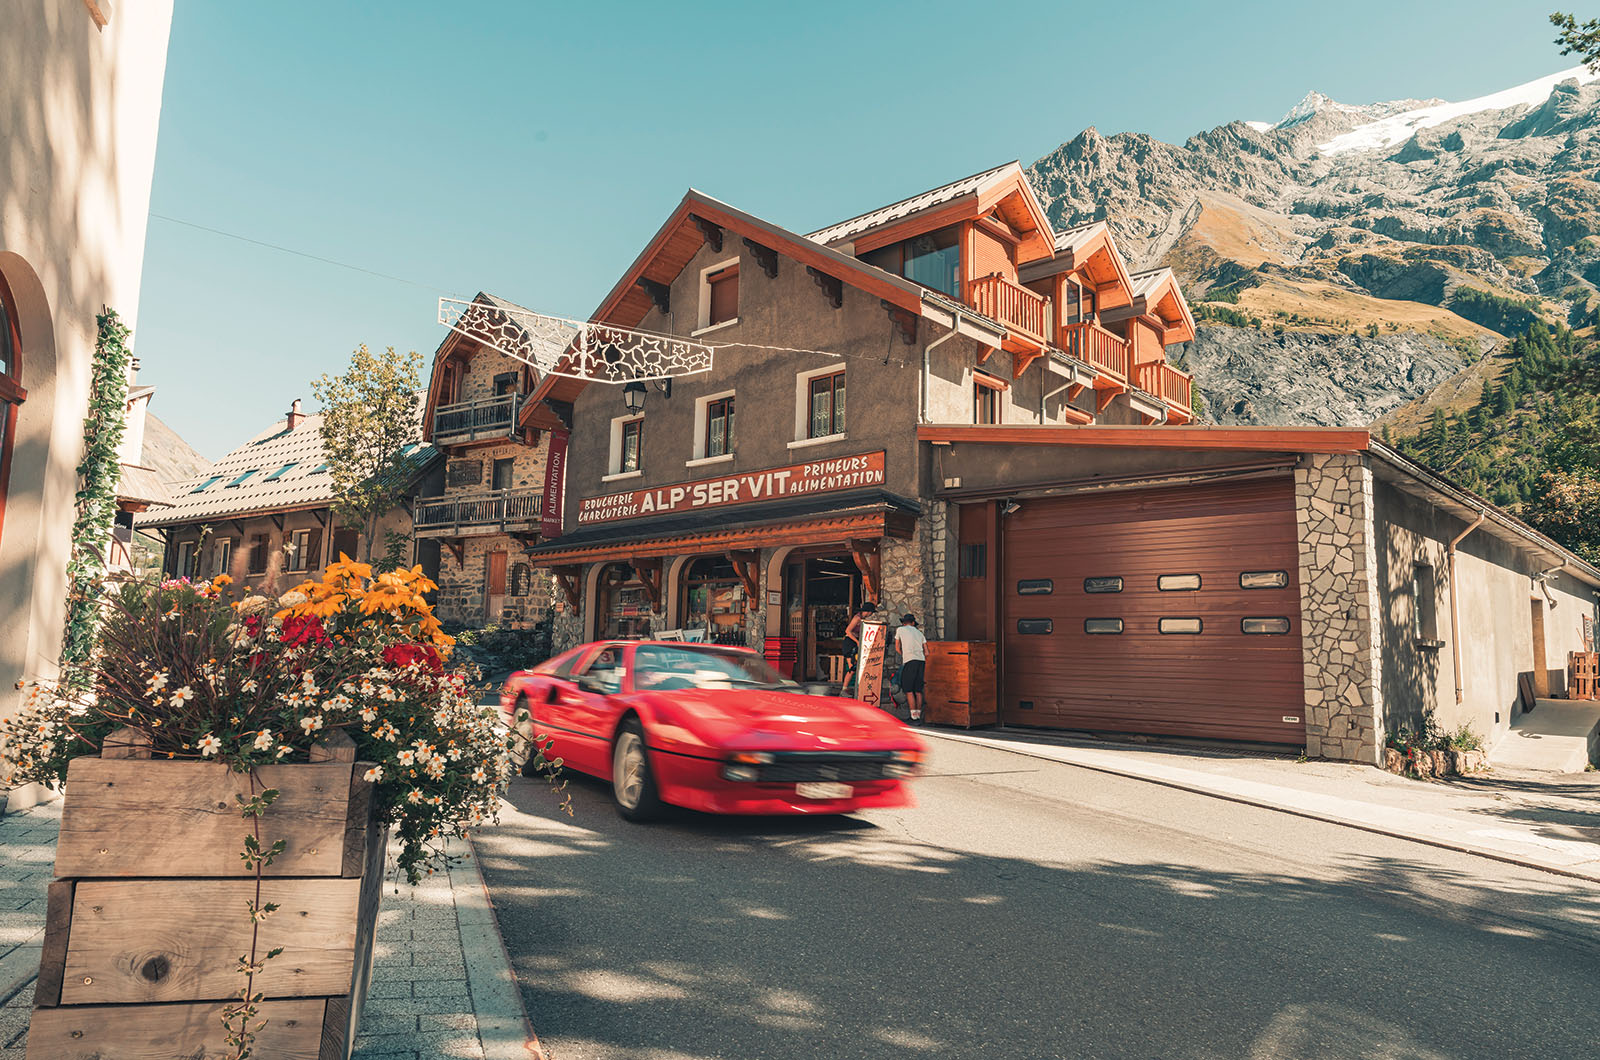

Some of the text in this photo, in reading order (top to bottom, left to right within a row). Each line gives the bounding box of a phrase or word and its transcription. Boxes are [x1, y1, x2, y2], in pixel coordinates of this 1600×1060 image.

[803, 456, 868, 477] PRIMEURS
[548, 452, 561, 515] ALIMENTATION
[640, 470, 792, 514] ALP'SER'VIT
[790, 470, 883, 494] ALIMENTATION
[584, 492, 634, 510] BOUCHERIE
[578, 503, 638, 522] CHARCUTERIE
